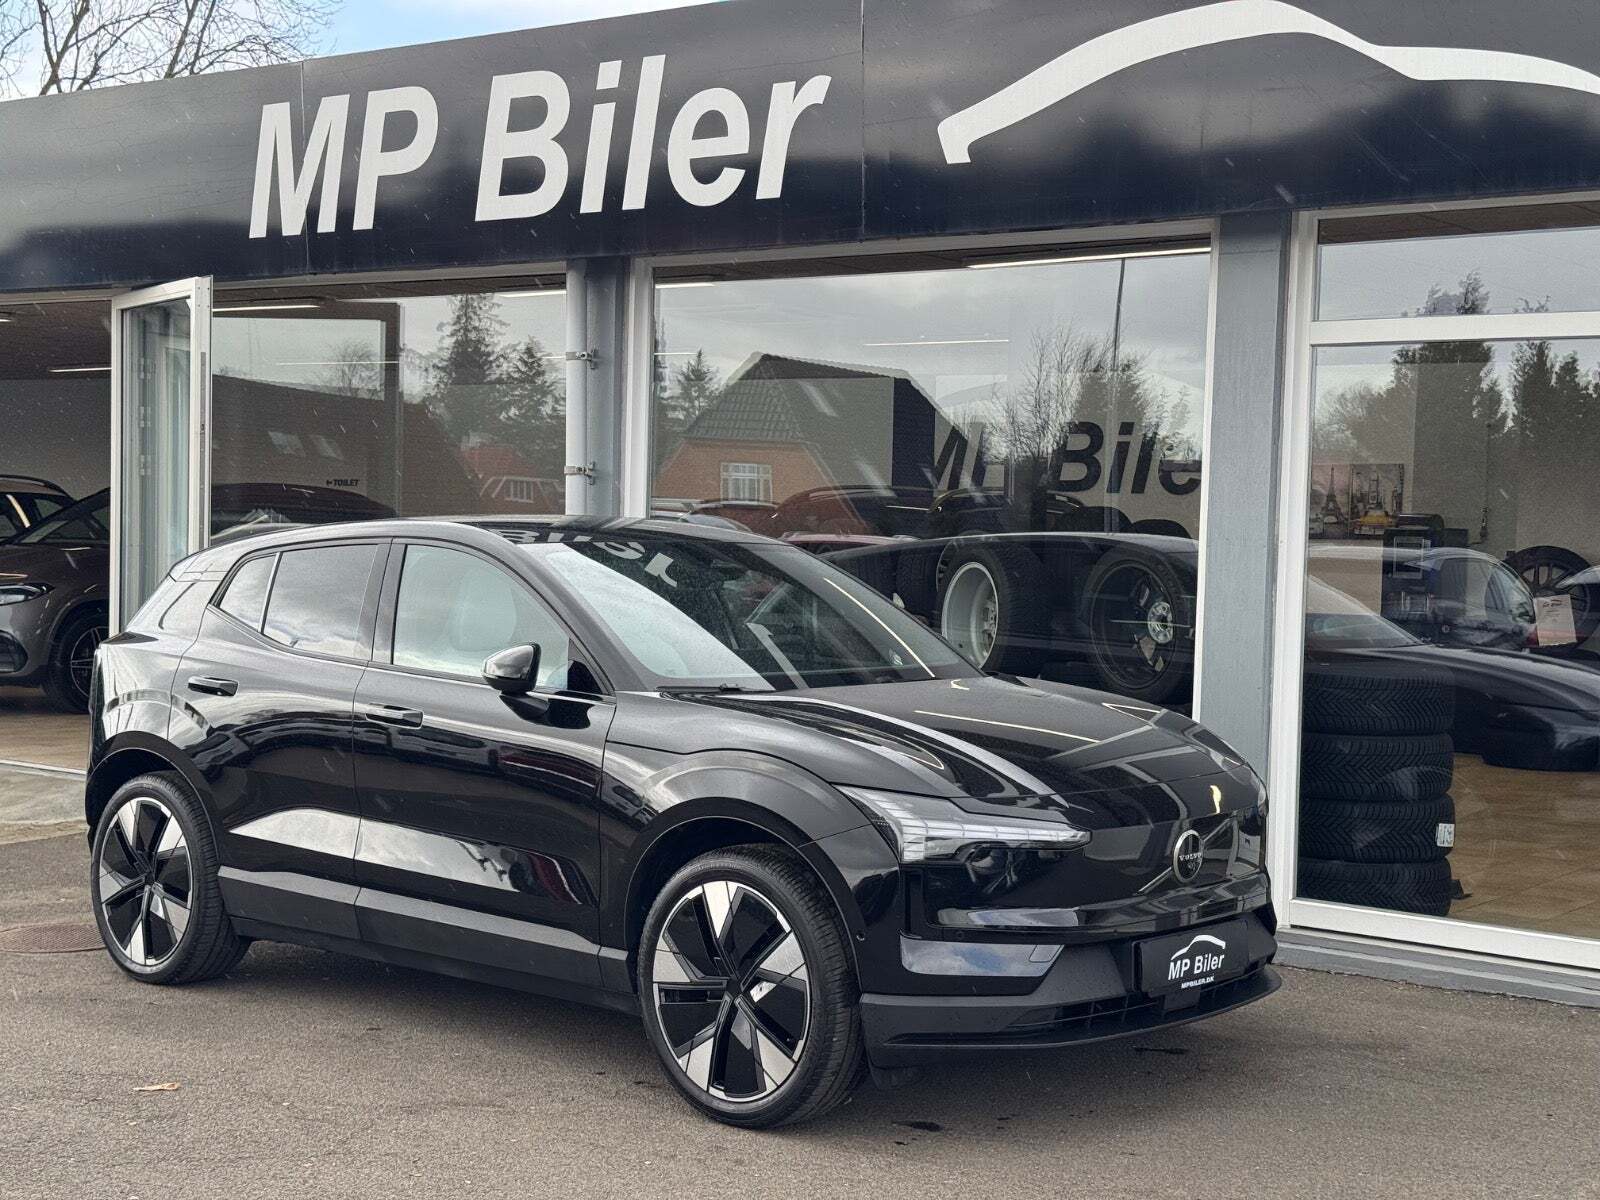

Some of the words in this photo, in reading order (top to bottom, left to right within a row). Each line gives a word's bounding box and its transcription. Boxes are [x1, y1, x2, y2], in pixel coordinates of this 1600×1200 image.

[248, 85, 439, 239] MP
[474, 54, 832, 222] Biler
[1168, 958, 1190, 980] MP
[1194, 953, 1225, 974] Biler
[1181, 975, 1215, 989] MPBILER.DK
